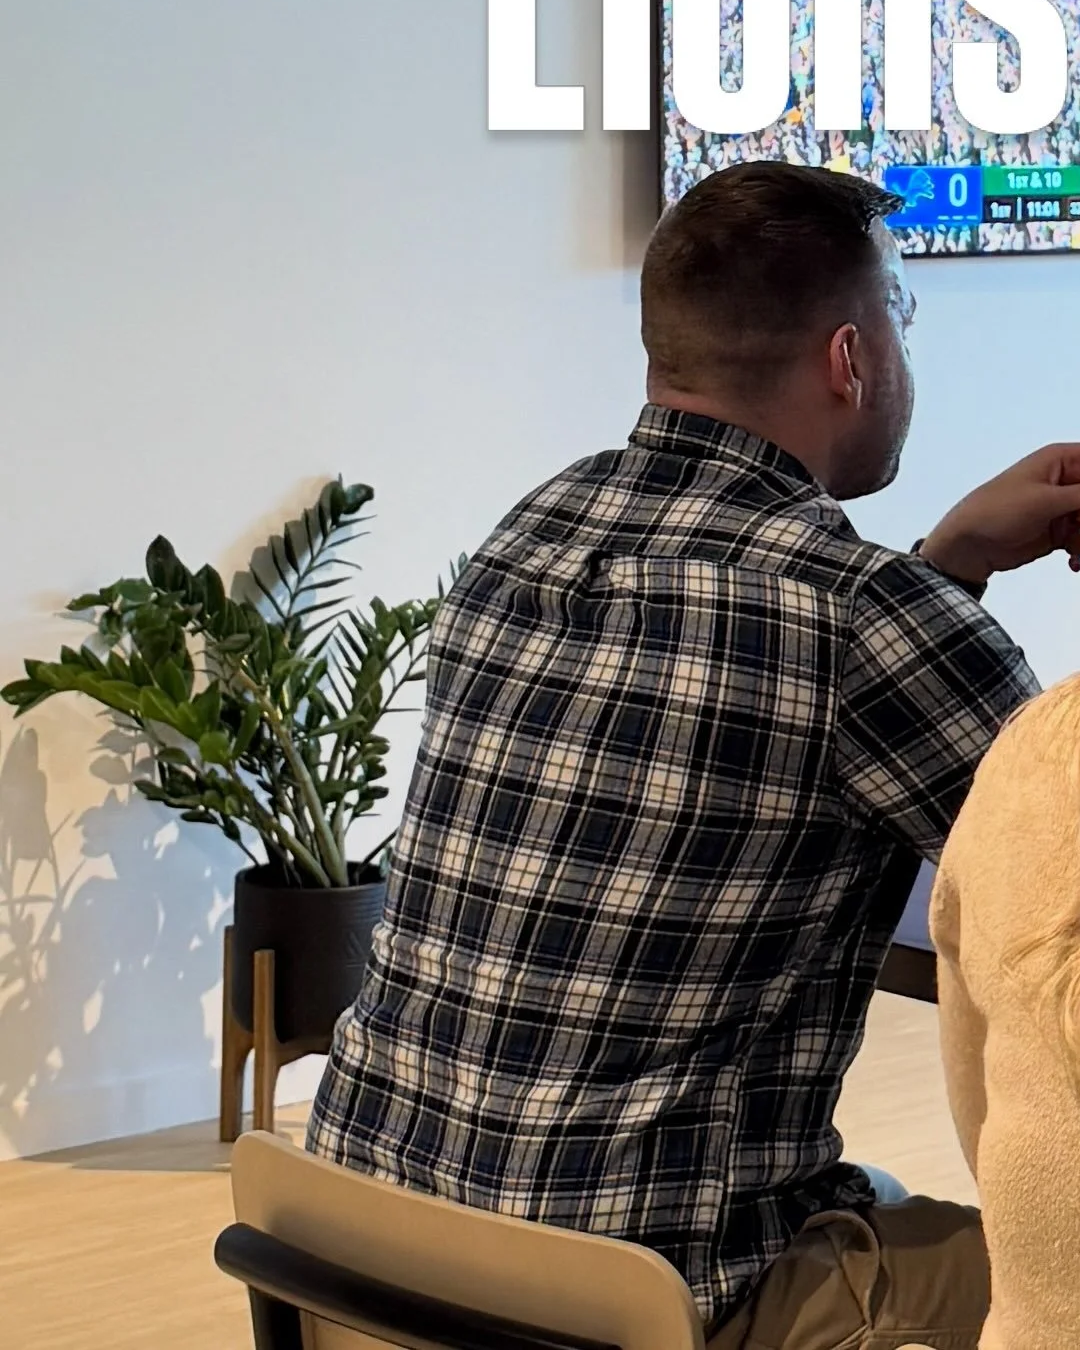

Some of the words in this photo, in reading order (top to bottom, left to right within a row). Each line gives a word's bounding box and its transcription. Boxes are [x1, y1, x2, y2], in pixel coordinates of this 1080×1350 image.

[949, 173, 968, 208] 0
[1030, 171, 1042, 189] &
[1044, 171, 1062, 188] 10
